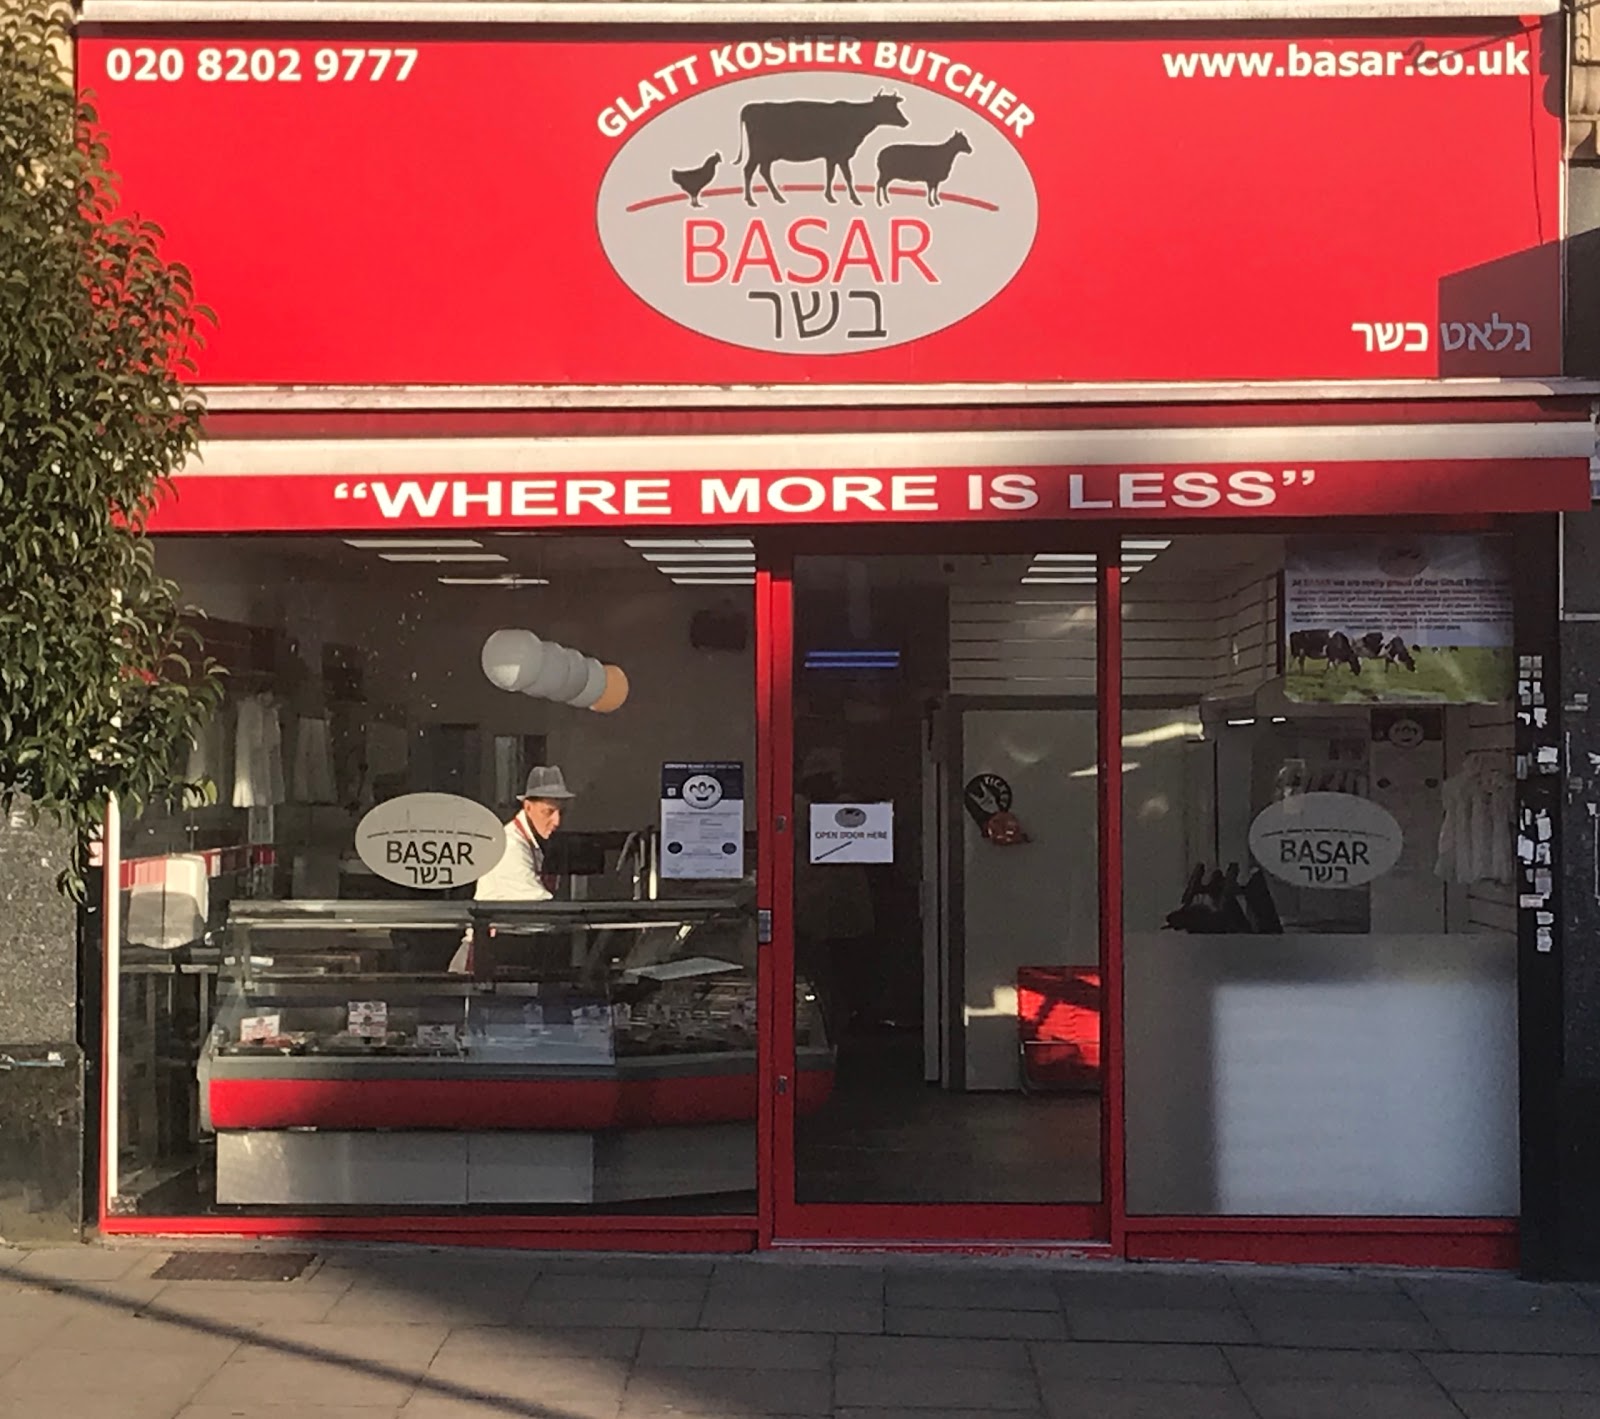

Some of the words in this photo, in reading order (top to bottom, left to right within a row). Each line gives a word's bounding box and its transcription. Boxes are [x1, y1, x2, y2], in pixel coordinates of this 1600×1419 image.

[106, 48, 183, 81] 020
[197, 48, 301, 81] 8202
[314, 48, 418, 81] 9777
[1162, 42, 1530, 78] www.basar.co.uk
[597, 55, 699, 138] GLATT
[709, 37, 862, 78] KOSHER
[874, 41, 1036, 139] BUTCHER
[685, 217, 938, 285] BASAR
[748, 290, 887, 339] בשר
[1351, 322, 1429, 352] כשר
[1440, 313, 1531, 352] גלאט
[334, 480, 672, 518] “WHERE
[701, 476, 938, 514] MORE
[968, 474, 1039, 510] IS
[1069, 469, 1316, 509] LESS”
[814, 831, 838, 839] OPEN
[840, 831, 865, 839] DOOR
[867, 831, 888, 839] HERE
[1280, 839, 1370, 865] BASAR
[386, 840, 474, 865] BASAR
[405, 866, 453, 885] בשר
